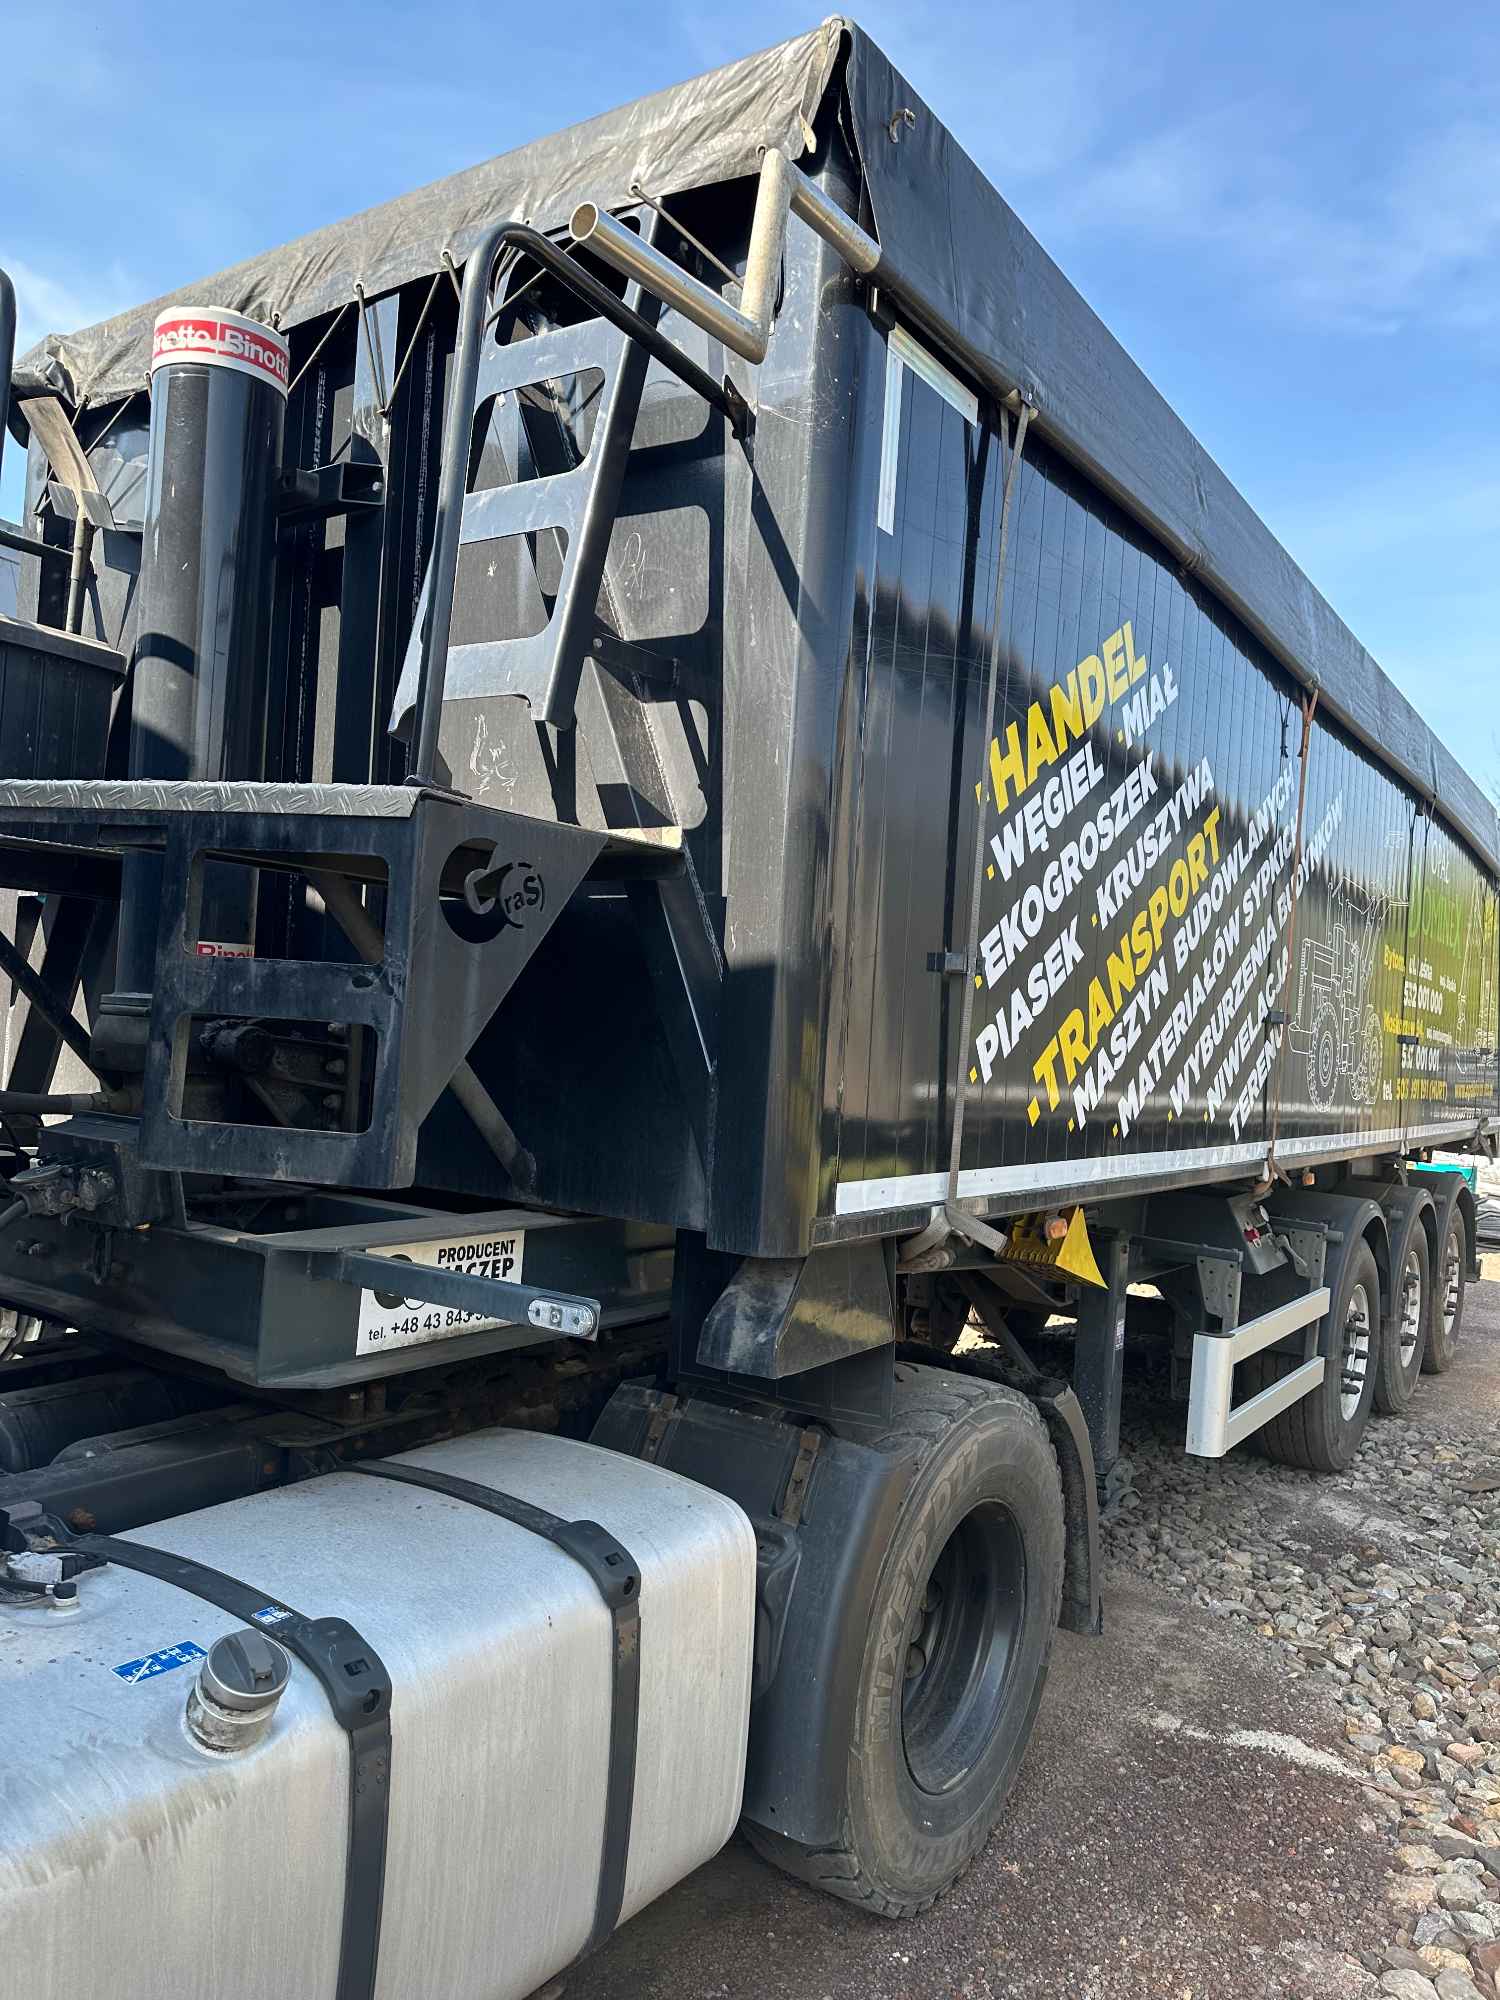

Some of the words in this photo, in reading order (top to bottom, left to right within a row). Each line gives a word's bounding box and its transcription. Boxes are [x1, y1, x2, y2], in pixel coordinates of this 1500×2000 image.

[990, 621, 1146, 814] HANDEL
[990, 741, 1104, 881] WĘGIEL
[1122, 662, 1178, 749] MIAŁ
[976, 915, 1084, 1084] PIASEK
[1096, 756, 1214, 930] KRUSZYWA
[980, 751, 1158, 989] EKOGROSZEK
[1033, 806, 1220, 1112] TRANSPORT
[1073, 956, 1168, 1130] MASZYN
[1173, 761, 1295, 973] BUDOWLANYCH
[1118, 906, 1240, 1138] MATERIAŁÓW
[1170, 914, 1277, 1118] WYBURZENIA
[368, 1326, 387, 1341] tel.
[391, 1316, 419, 1335] +48
[424, 1312, 442, 1331] 43
[438, 1239, 516, 1264] PRODUCENT
[445, 1257, 514, 1279] CZEP
